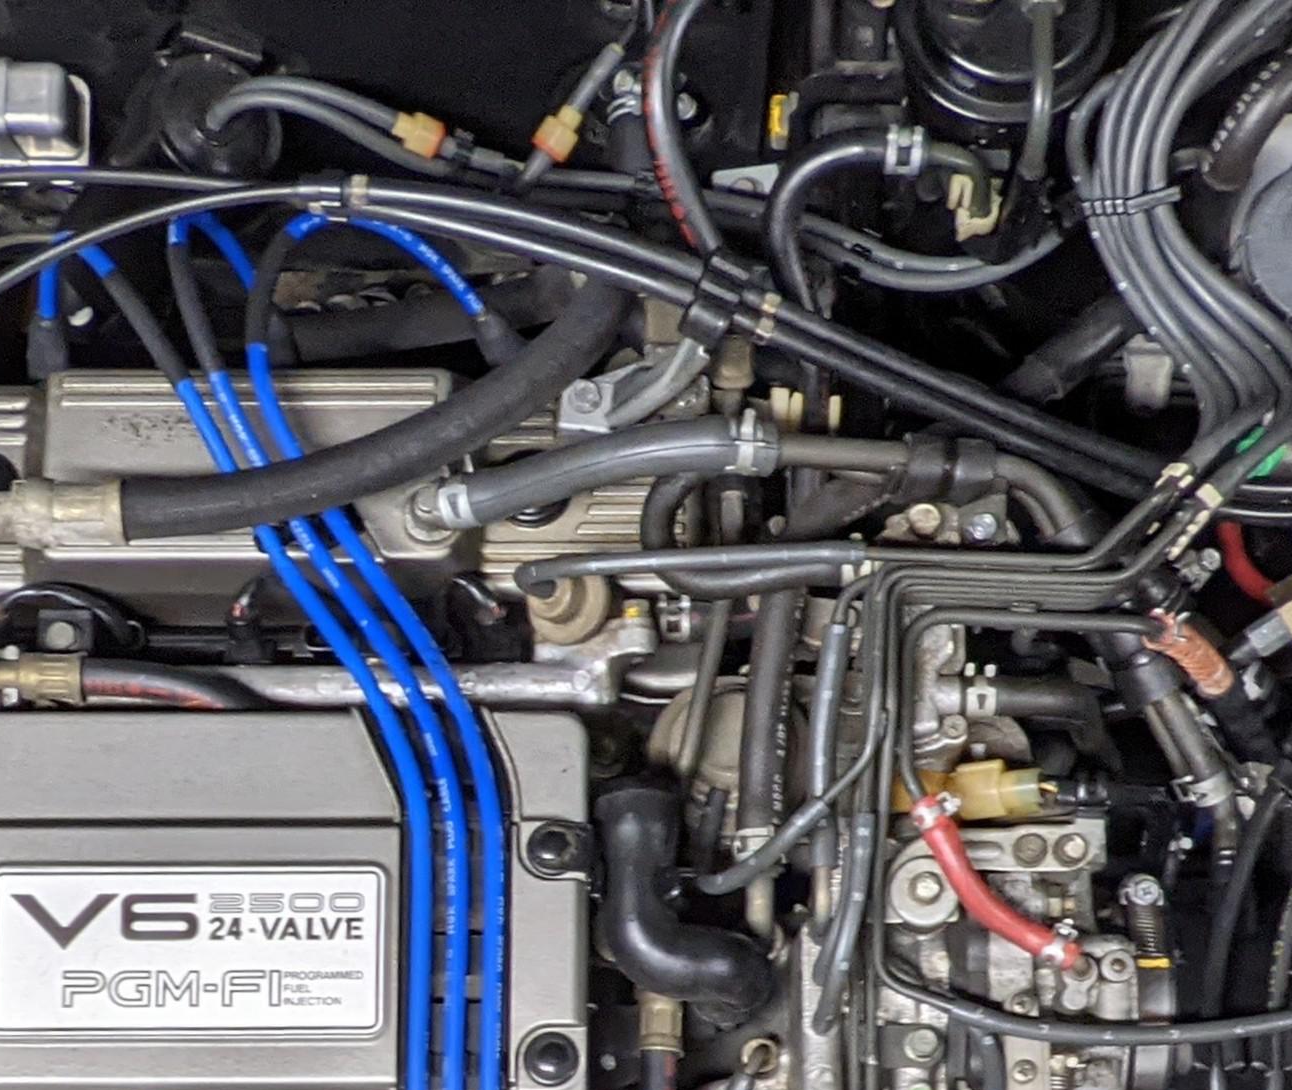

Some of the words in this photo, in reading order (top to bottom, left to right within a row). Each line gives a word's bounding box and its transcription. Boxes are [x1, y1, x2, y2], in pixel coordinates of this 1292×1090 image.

[209, 892, 365, 914] 2500
[10, 893, 199, 950] V6
[284, 970, 364, 980] PROGRAMMED
[62, 969, 281, 1008] PGM-FI
[283, 984, 312, 994] FUEL
[283, 997, 343, 1006] INJECTION
